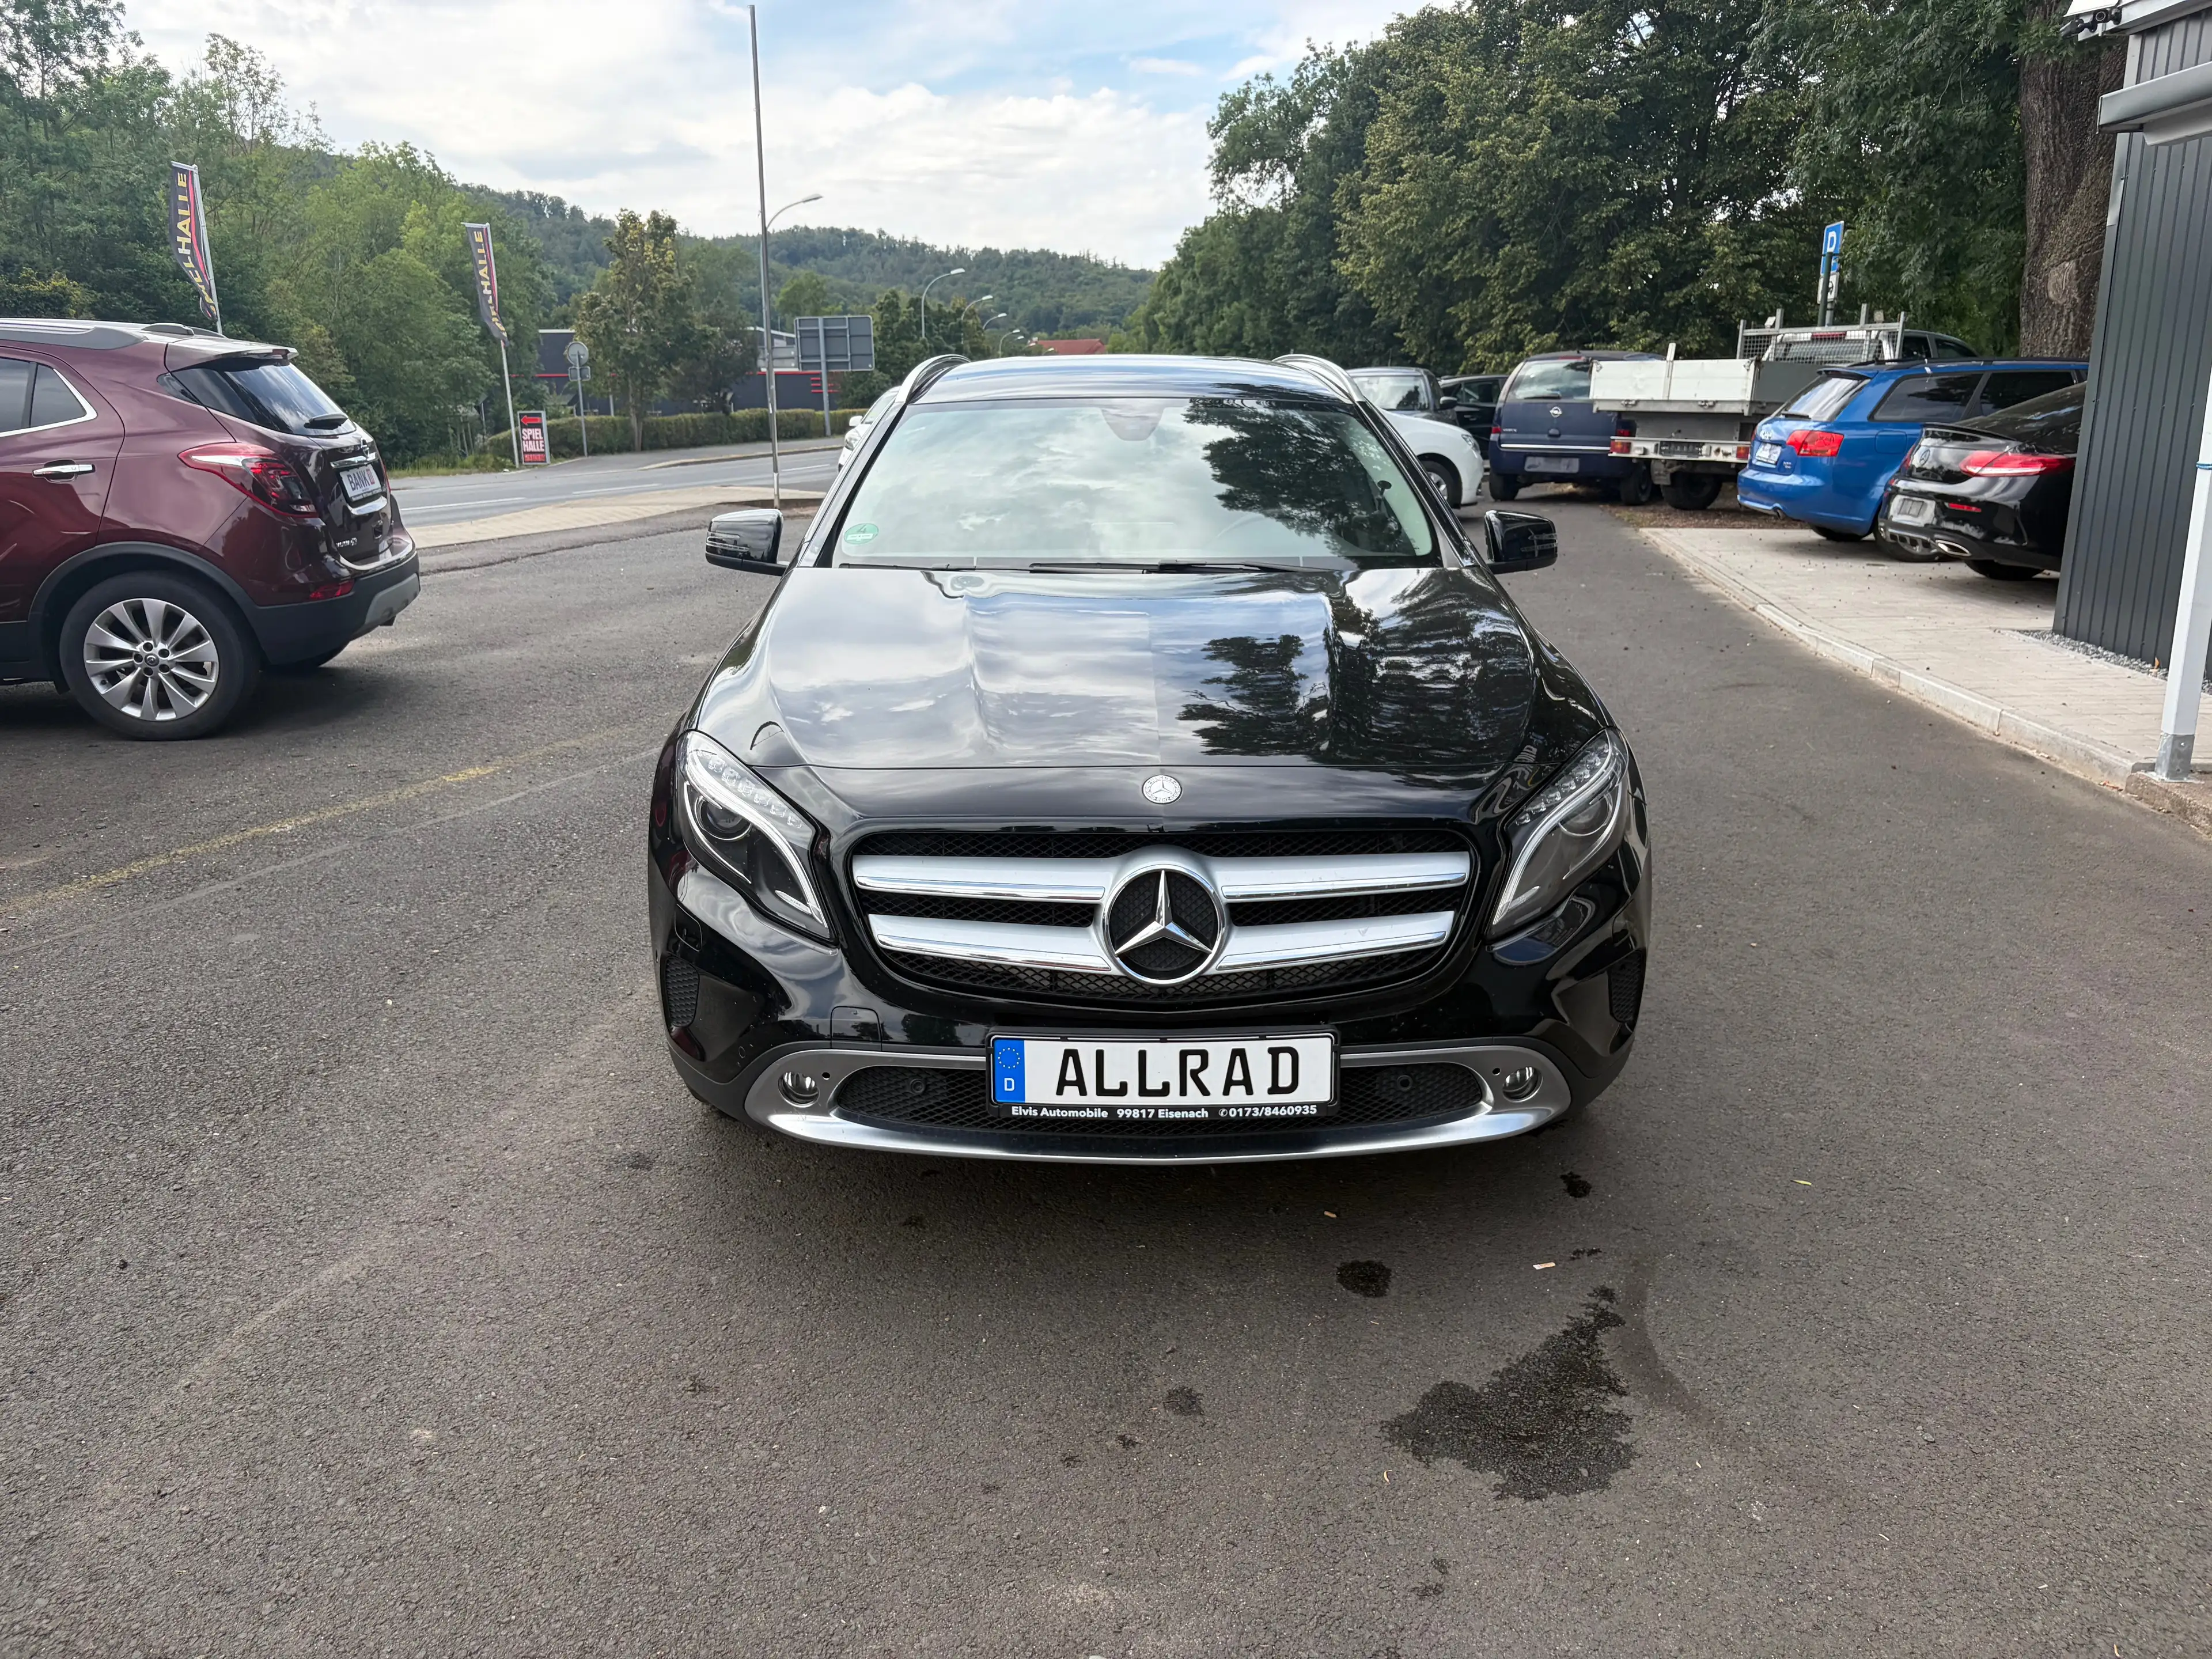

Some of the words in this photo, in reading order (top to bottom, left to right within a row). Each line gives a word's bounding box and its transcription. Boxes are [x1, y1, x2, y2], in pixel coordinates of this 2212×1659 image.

[522, 428, 543, 440] SPIEL
[522, 440, 544, 452] HALLE
[1056, 1046, 1299, 1096] ALLRAD
[1004, 1078, 1014, 1091] D
[1012, 1106, 1038, 1116] Elvis
[1040, 1107, 1108, 1118] Automobile
[1116, 1108, 1155, 1118] 99817
[1158, 1108, 1209, 1118] Eisenach
[1229, 1105, 1317, 1117] 0173/8460935
